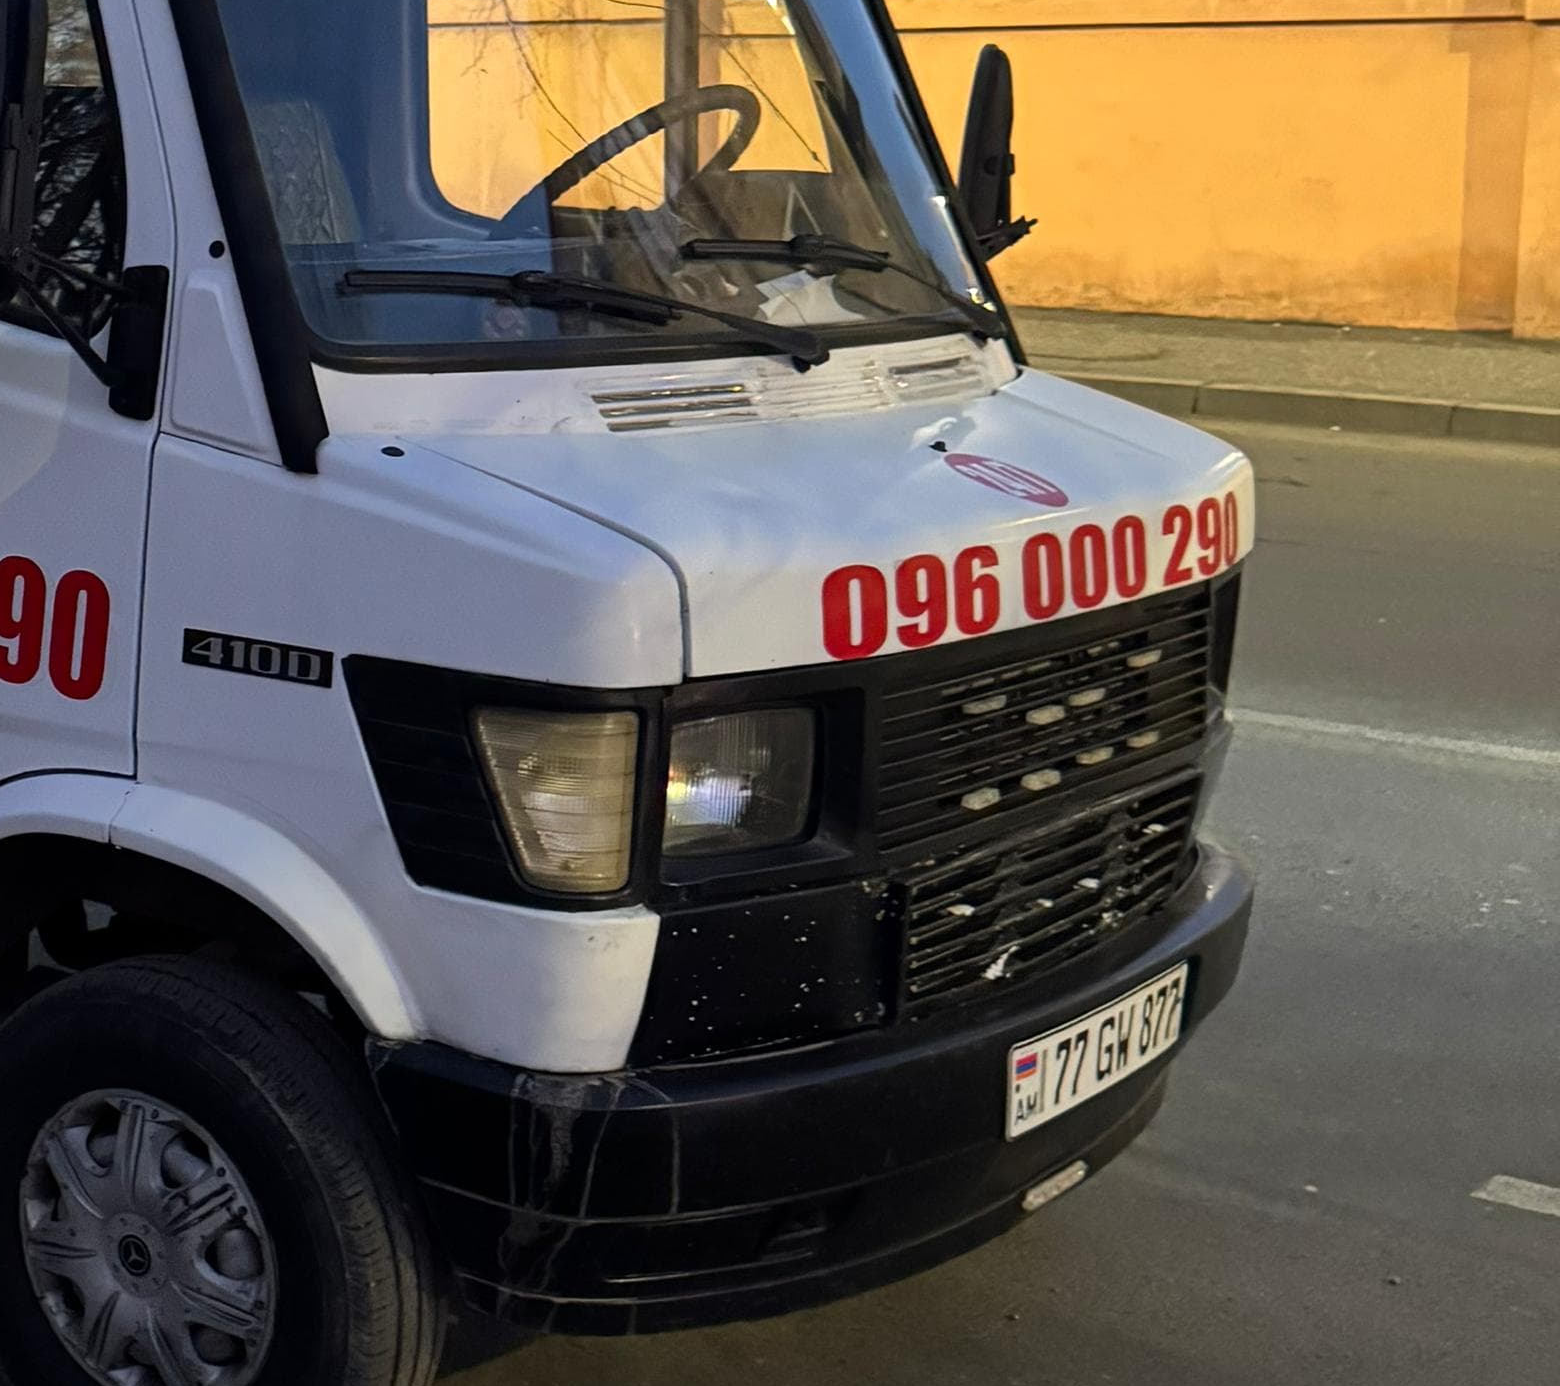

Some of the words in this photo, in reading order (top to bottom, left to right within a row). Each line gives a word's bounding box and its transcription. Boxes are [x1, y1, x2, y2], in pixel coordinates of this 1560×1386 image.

[822, 545, 1000, 660] 096
[1022, 515, 1147, 621] 000
[1161, 491, 1238, 586] 290
[1054, 1028, 1090, 1106] 77
[1139, 977, 1181, 1056] 877
[1015, 1091, 1039, 1125] AM
